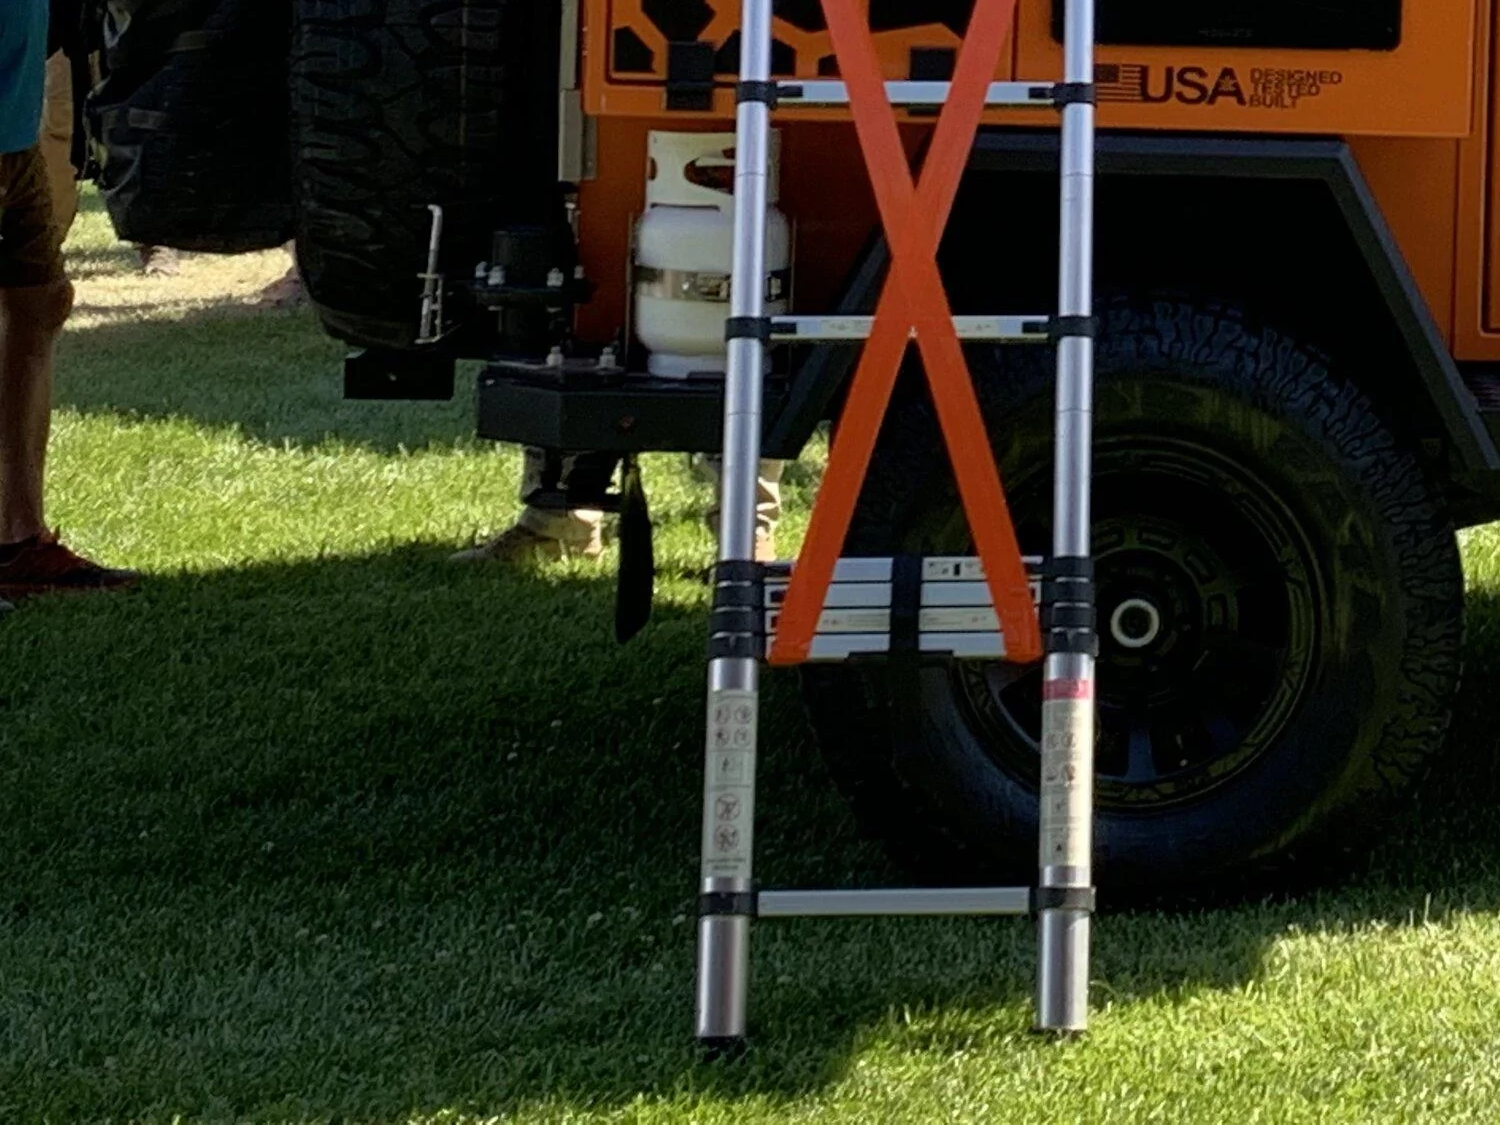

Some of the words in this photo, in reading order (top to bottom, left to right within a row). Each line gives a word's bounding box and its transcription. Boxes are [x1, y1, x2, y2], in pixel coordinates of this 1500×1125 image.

[1250, 67, 1342, 85] DESIGNED
[1139, 66, 1247, 106] USA
[1251, 82, 1321, 97] TESTED
[1250, 95, 1300, 109] BUILT
